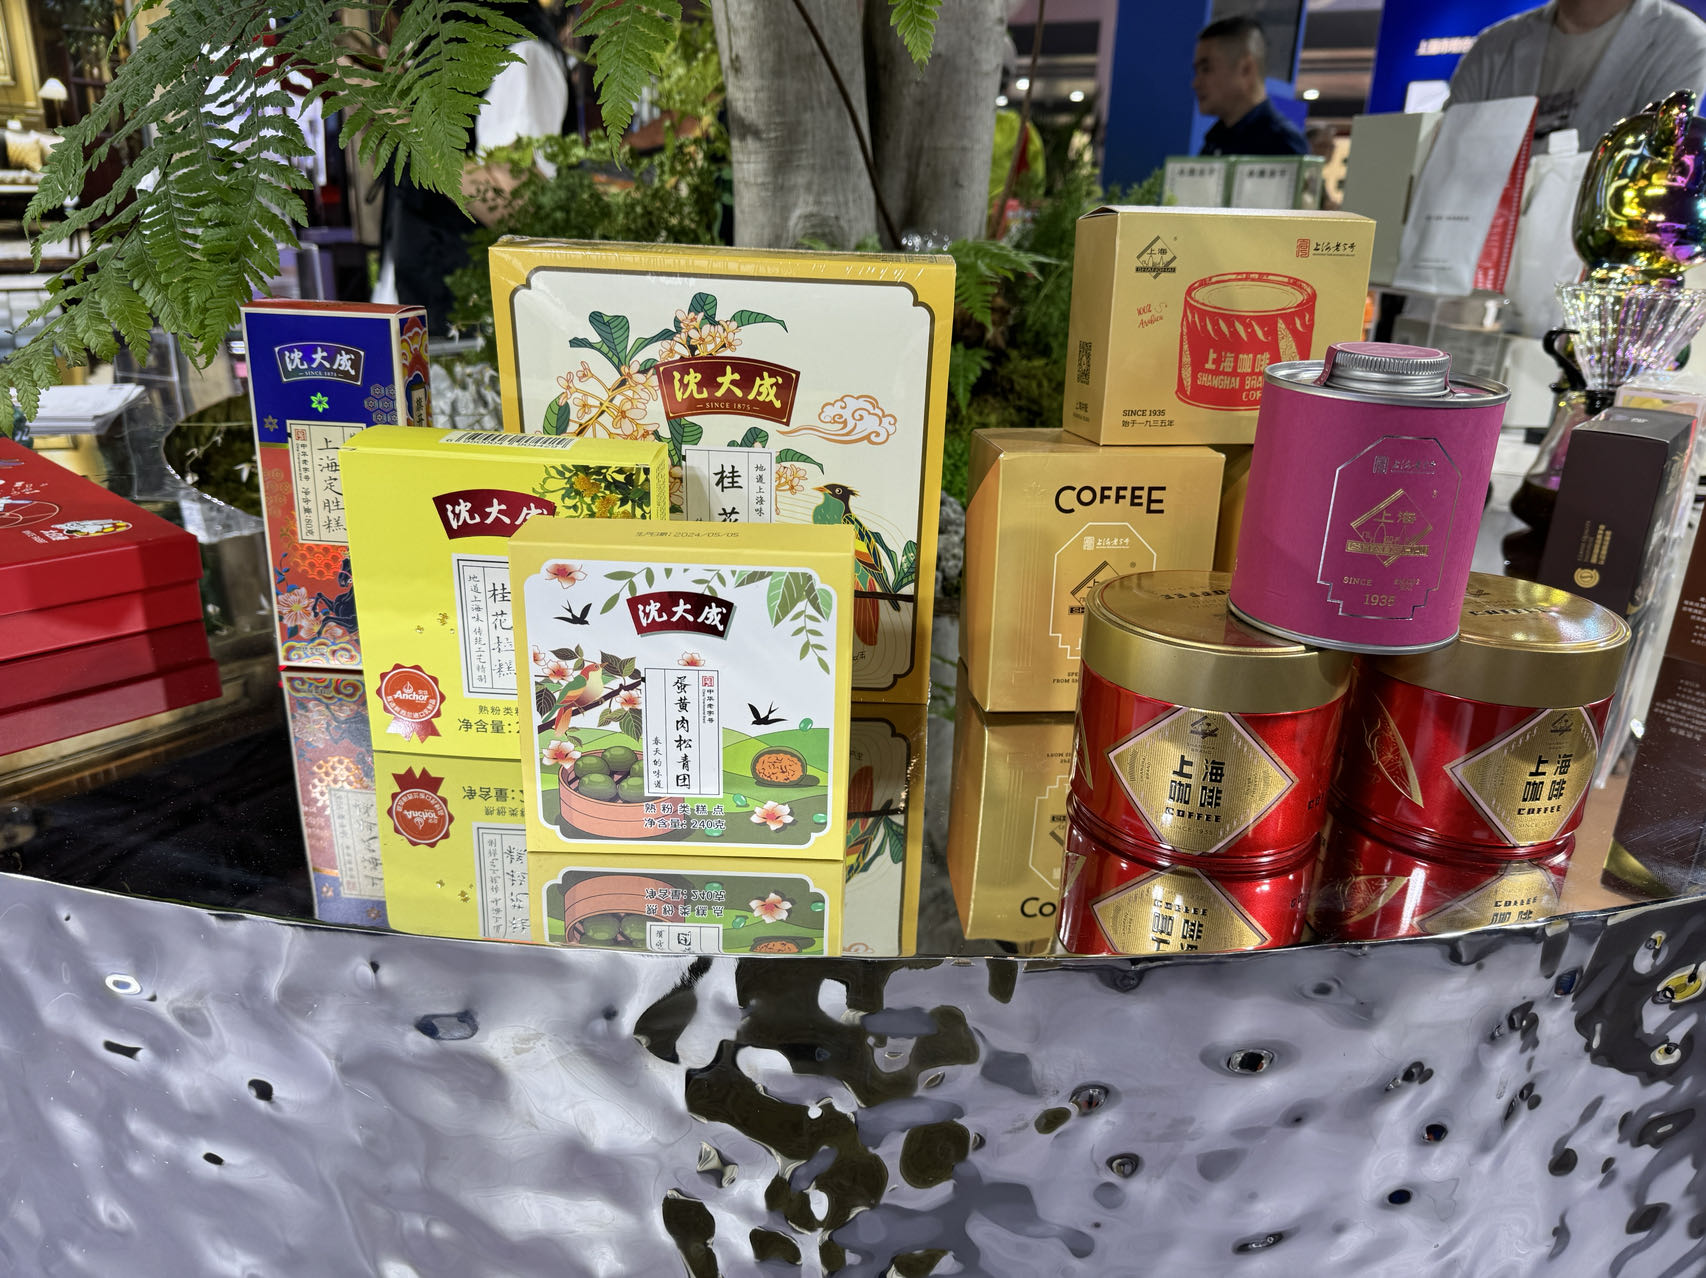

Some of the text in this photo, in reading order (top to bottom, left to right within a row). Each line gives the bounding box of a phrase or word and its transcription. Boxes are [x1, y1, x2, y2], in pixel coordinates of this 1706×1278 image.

[284, 347, 356, 375] 沈大成
[1205, 348, 1270, 373] 上海咖啡
[672, 365, 782, 408] 沈大成
[1197, 372, 1264, 389] SHANGHAI BRA
[754, 463, 767, 518] 地道上海味
[1054, 485, 1166, 514] COFFEE
[1374, 511, 1416, 524] 上海
[1343, 576, 1373, 586] SINCE
[637, 599, 727, 631] 沈大成
[393, 690, 429, 700] Anchor
[673, 676, 693, 790] 蛋黄肉松青团
[652, 737, 664, 789] 春天的味道
[1172, 754, 1226, 783] 上海
[1529, 753, 1573, 777] 上海
[1168, 779, 1223, 808] 咖啡
[1522, 778, 1567, 802] 咖啡
[644, 803, 725, 816] 熟粉类糕点
[1166, 807, 1222, 823] COFFEE
[1517, 804, 1562, 815] COFFEE
